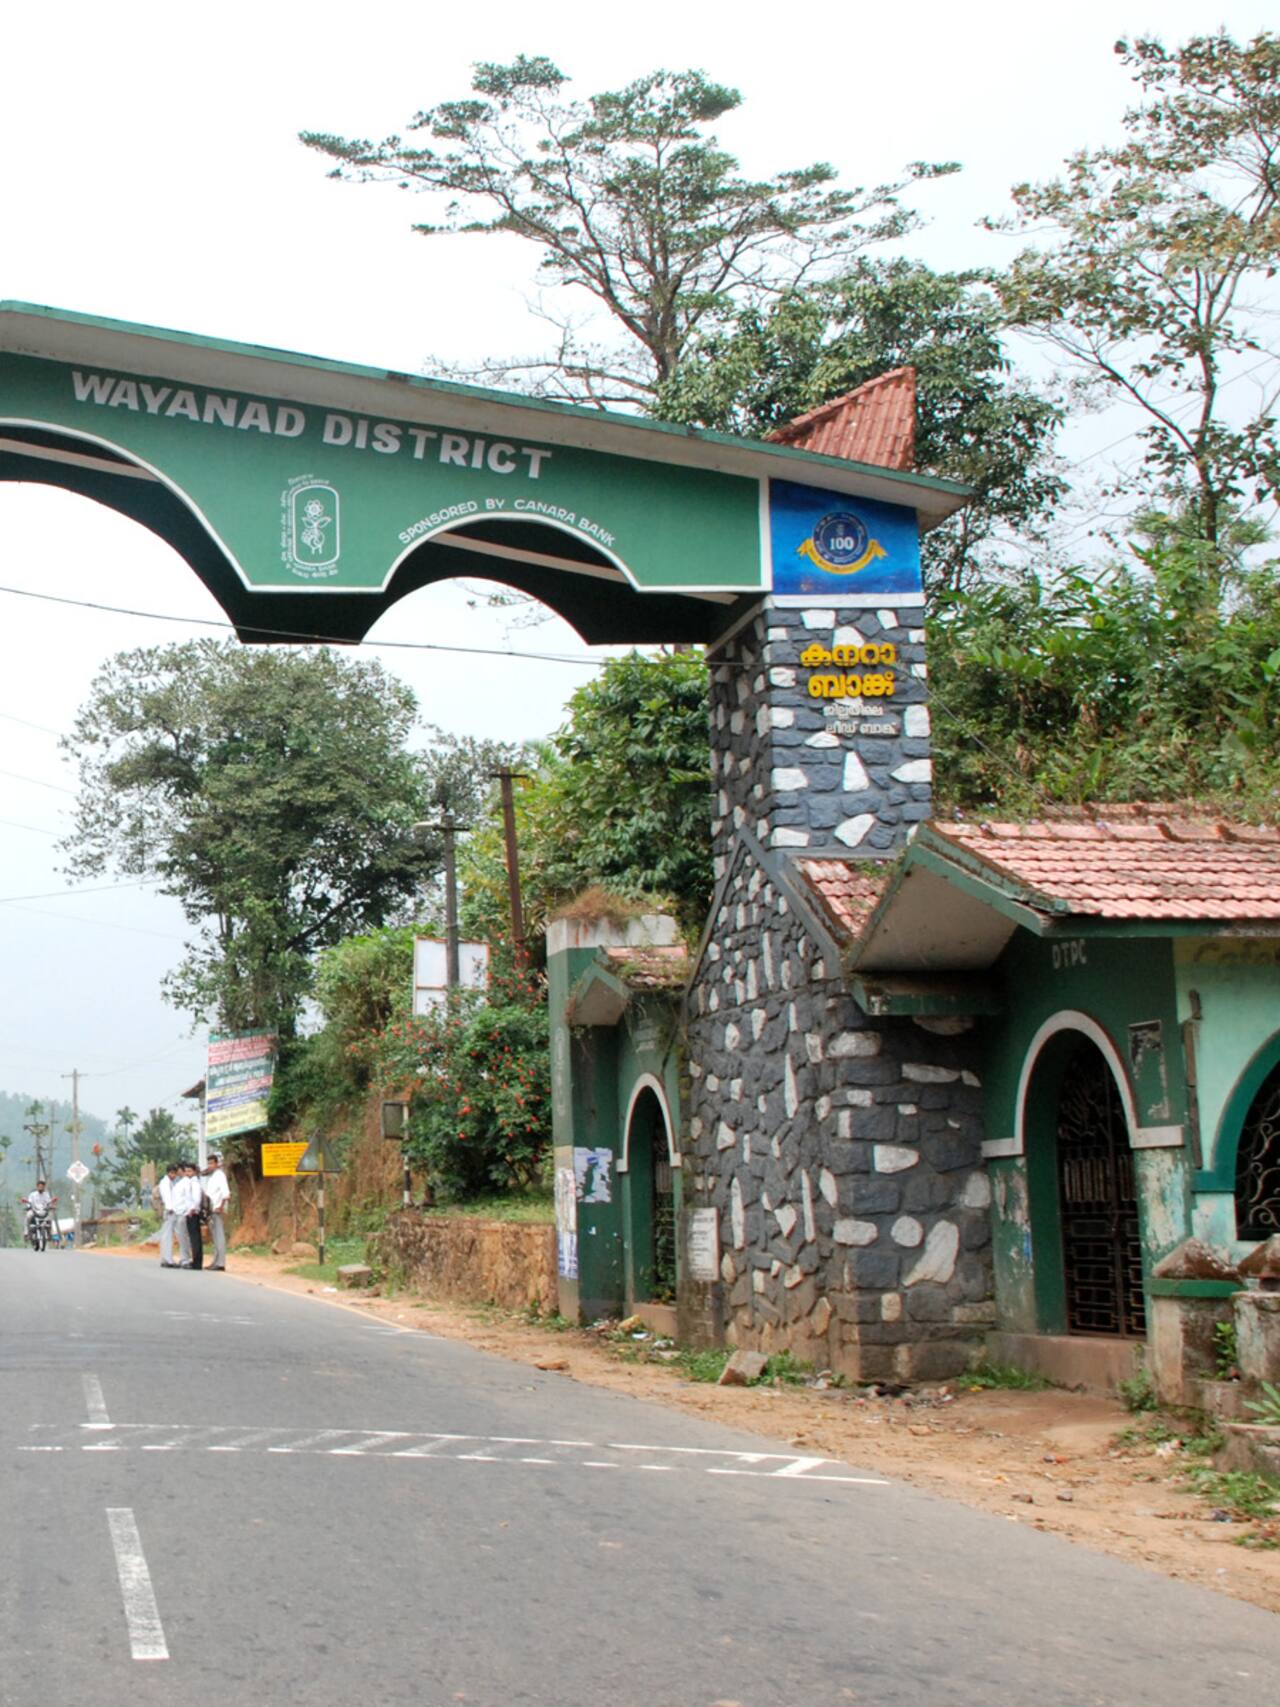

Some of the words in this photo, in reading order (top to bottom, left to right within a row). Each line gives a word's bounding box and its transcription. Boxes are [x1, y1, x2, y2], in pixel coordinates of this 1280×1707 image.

[72, 371, 307, 438] WAYANAD
[322, 414, 553, 479] DISTRICT
[398, 501, 478, 544] SPONSORED
[485, 498, 505, 509] BY
[514, 499, 576, 524] CANARA
[577, 517, 616, 547] BANK
[829, 536, 855, 550] 100
[800, 643, 896, 667] കനറാ
